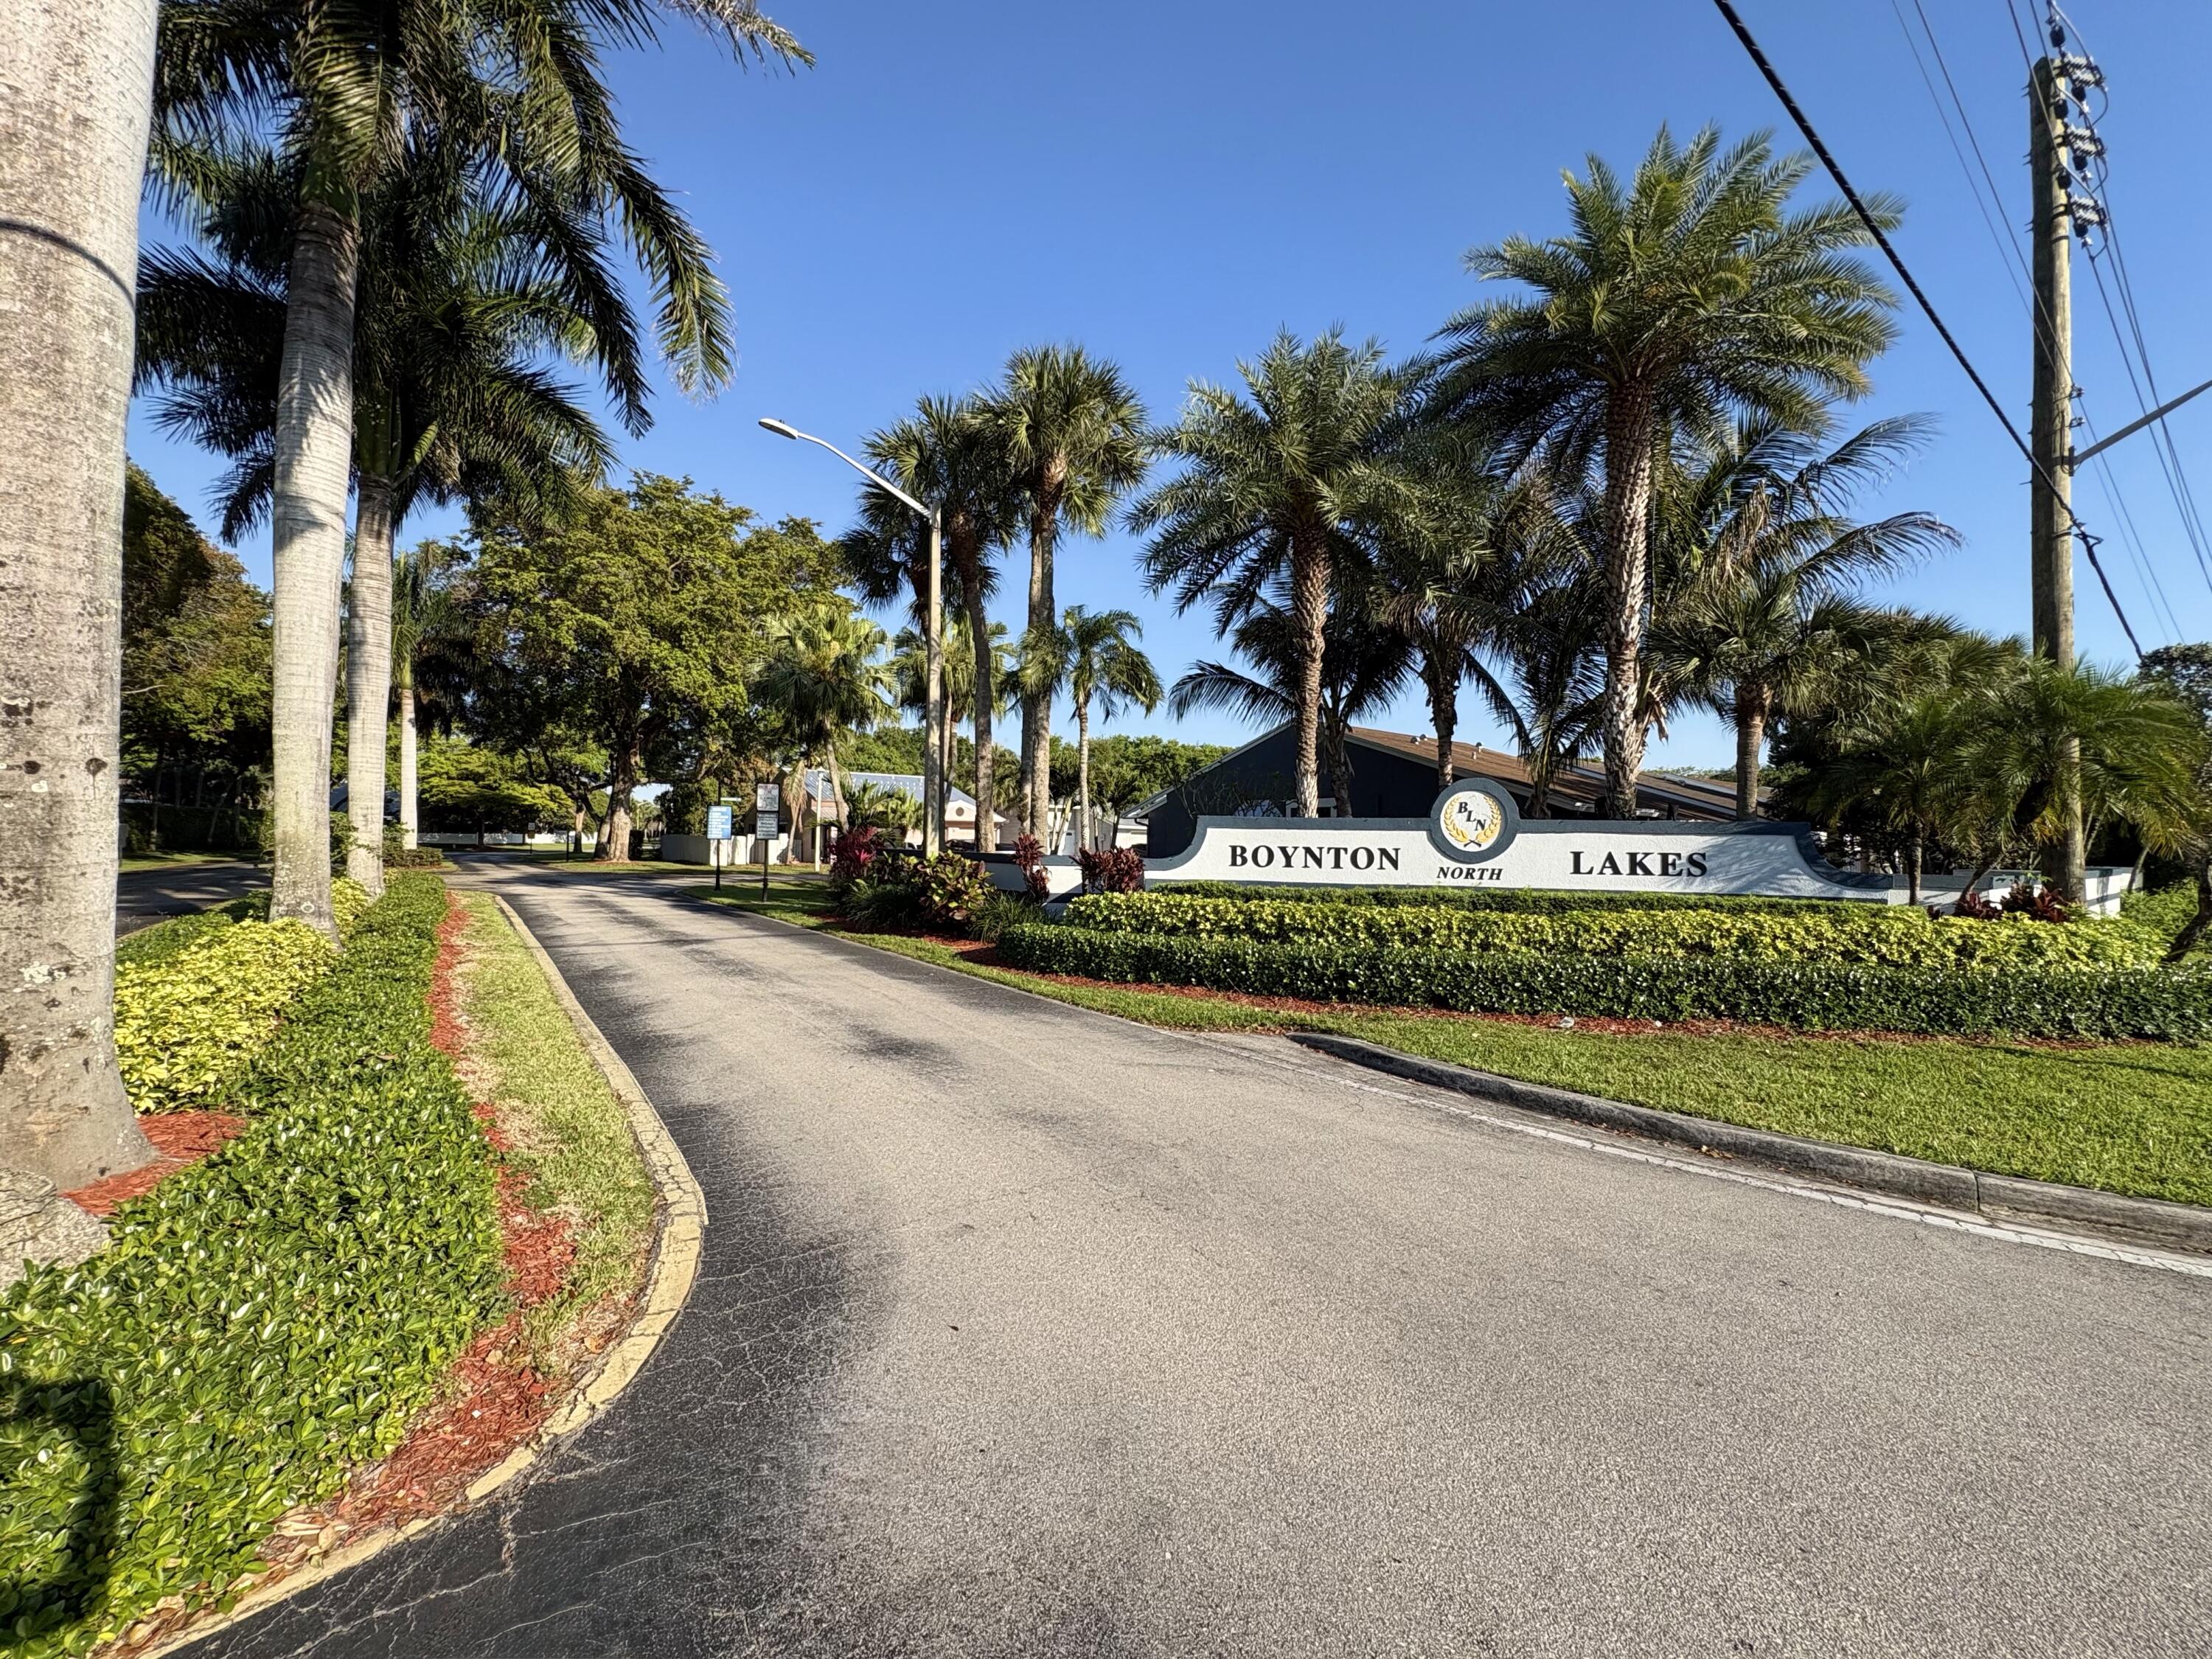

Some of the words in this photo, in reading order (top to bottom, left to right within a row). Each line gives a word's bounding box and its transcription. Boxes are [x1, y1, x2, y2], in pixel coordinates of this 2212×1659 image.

[1228, 845, 1401, 871] BOYNTON
[1569, 851, 1708, 877] LAKES
[1436, 866, 1503, 880] NORTH
